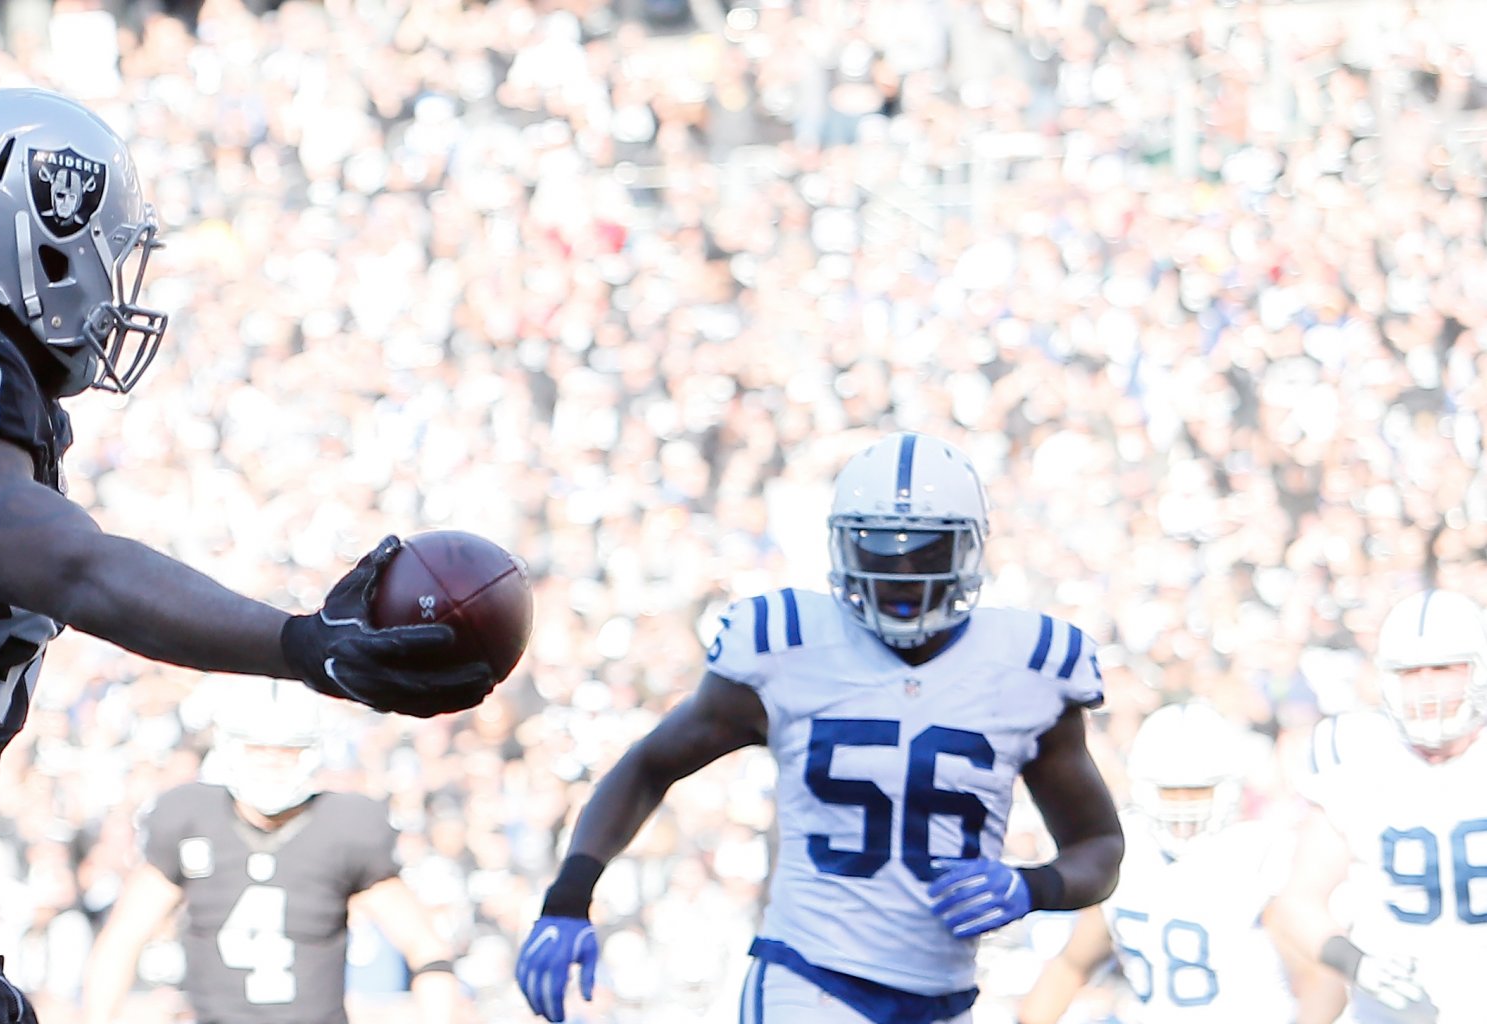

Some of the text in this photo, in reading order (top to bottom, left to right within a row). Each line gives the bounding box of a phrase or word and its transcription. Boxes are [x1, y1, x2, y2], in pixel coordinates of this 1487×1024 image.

[34, 151, 100, 175] RAIDERS
[805, 718, 996, 882] 56
[217, 883, 297, 1004] 4
[1112, 907, 1220, 1008] 58
